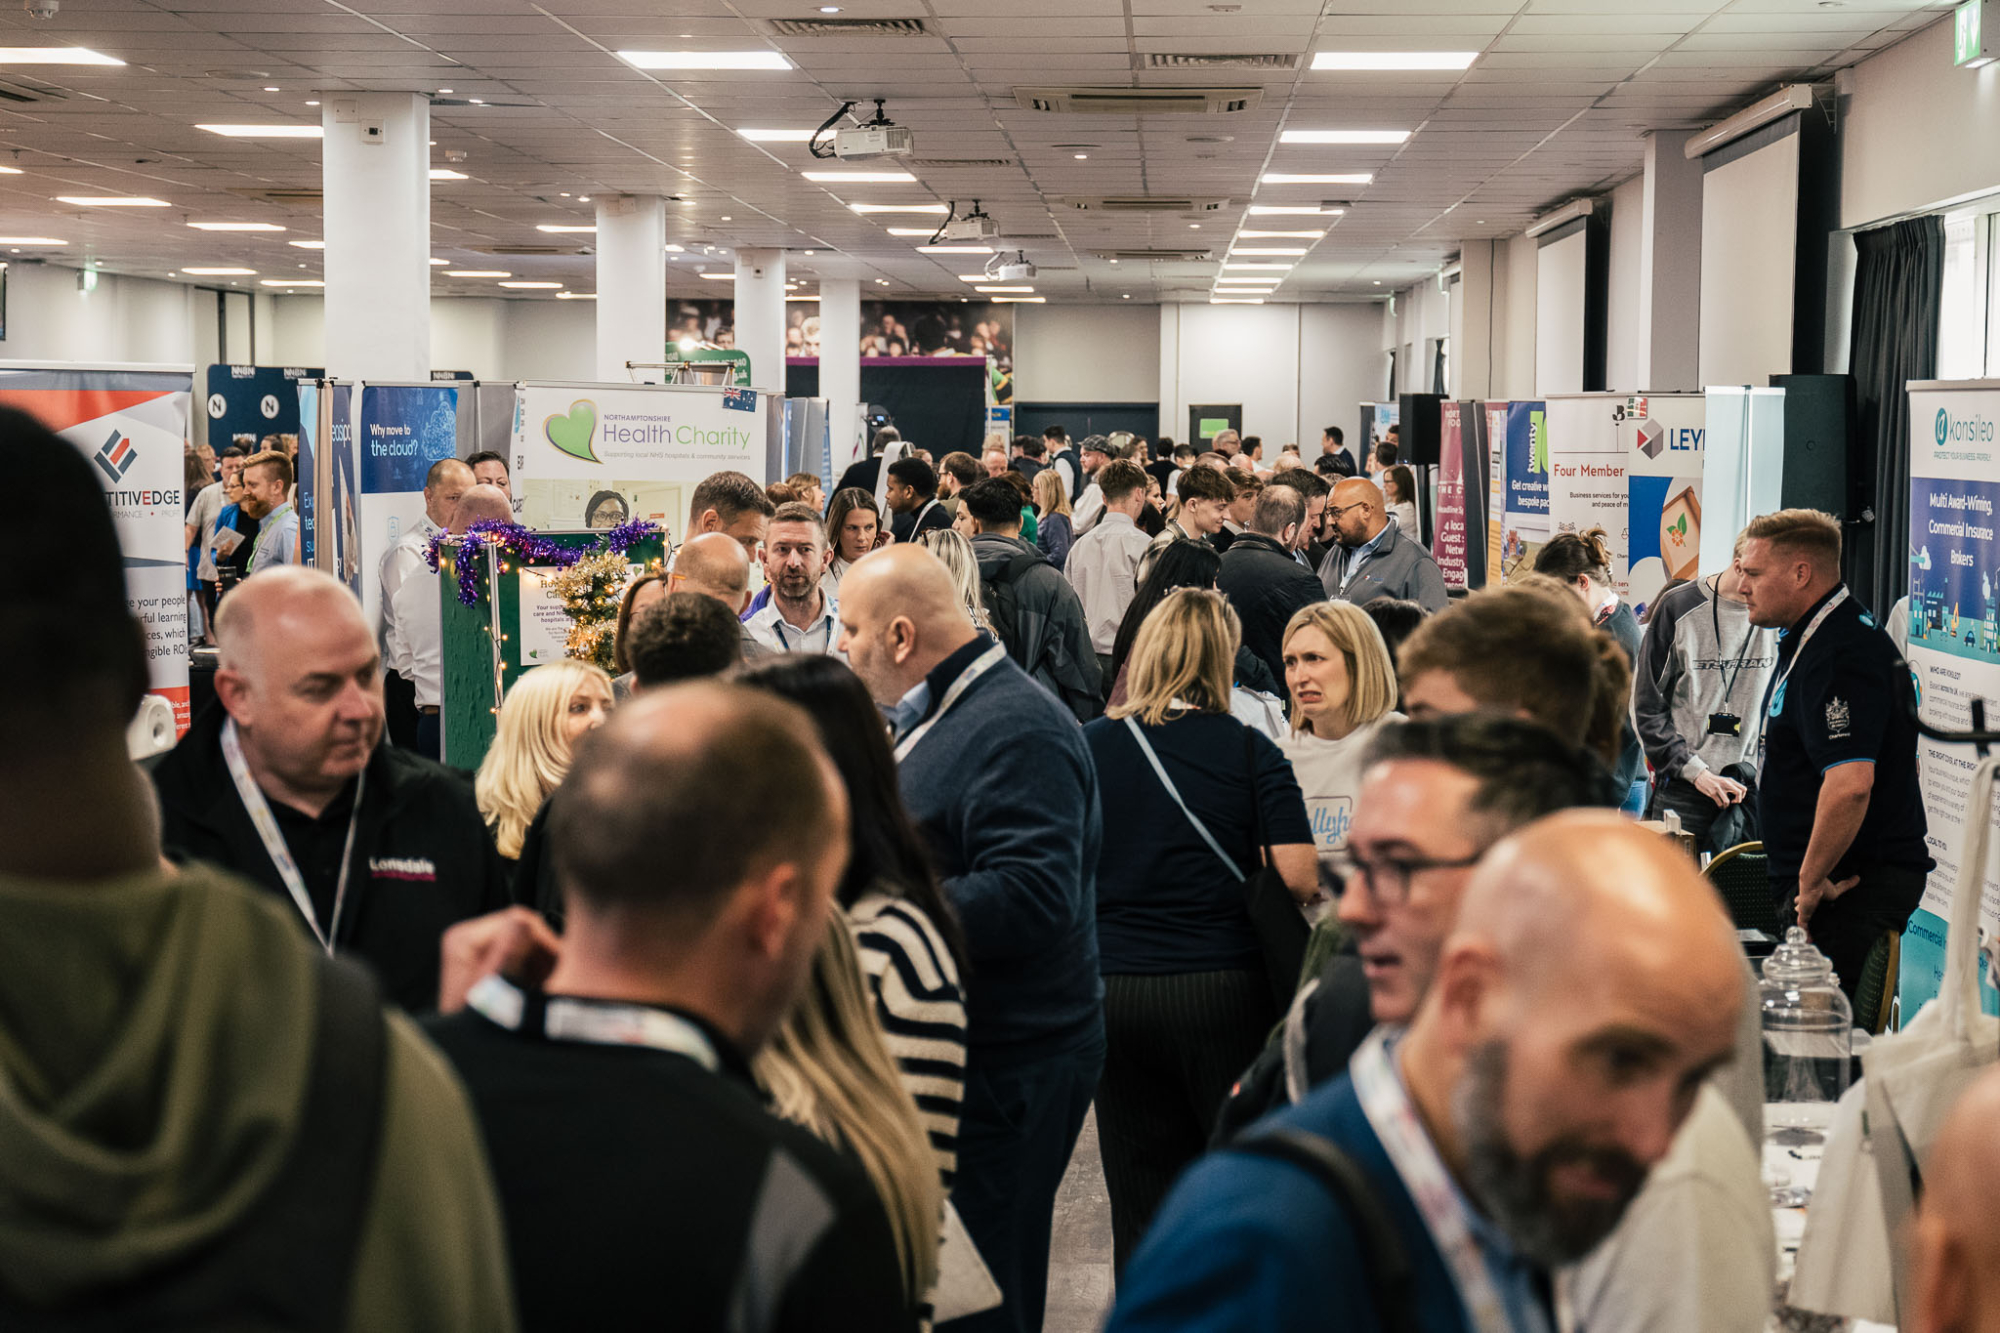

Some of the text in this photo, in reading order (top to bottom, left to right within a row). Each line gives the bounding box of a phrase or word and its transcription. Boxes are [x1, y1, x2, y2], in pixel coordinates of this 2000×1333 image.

[212, 399, 221, 412] N
[265, 400, 274, 412] N
[603, 414, 671, 422] NORTHAMPTONSHIRE
[370, 423, 411, 438] Why move to
[1950, 413, 1994, 442] konsileo
[603, 424, 751, 450] Health Charity
[1670, 428, 1705, 451] LEY
[371, 439, 418, 456] the cloud?
[1527, 422, 1537, 474] twenty
[1554, 464, 1625, 477] Four Member
[105, 490, 180, 506] TITIVEDGE
[1569, 491, 1591, 499] Business
[1929, 492, 1947, 509] Multi
[1540, 498, 1549, 509] pac
[112, 511, 142, 519] RMANCE
[1444, 520, 1464, 531] 4 loca
[1929, 519, 1993, 541] Commercial Insurance
[1440, 531, 1461, 543] Guest
[1445, 544, 1465, 555] Netw
[1951, 549, 1974, 567] Brokers
[1443, 567, 1464, 582] Engag
[137, 599, 158, 610] your
[140, 612, 155, 624] rful
[146, 646, 171, 660] ngible
[1907, 919, 1942, 947] Commercial
